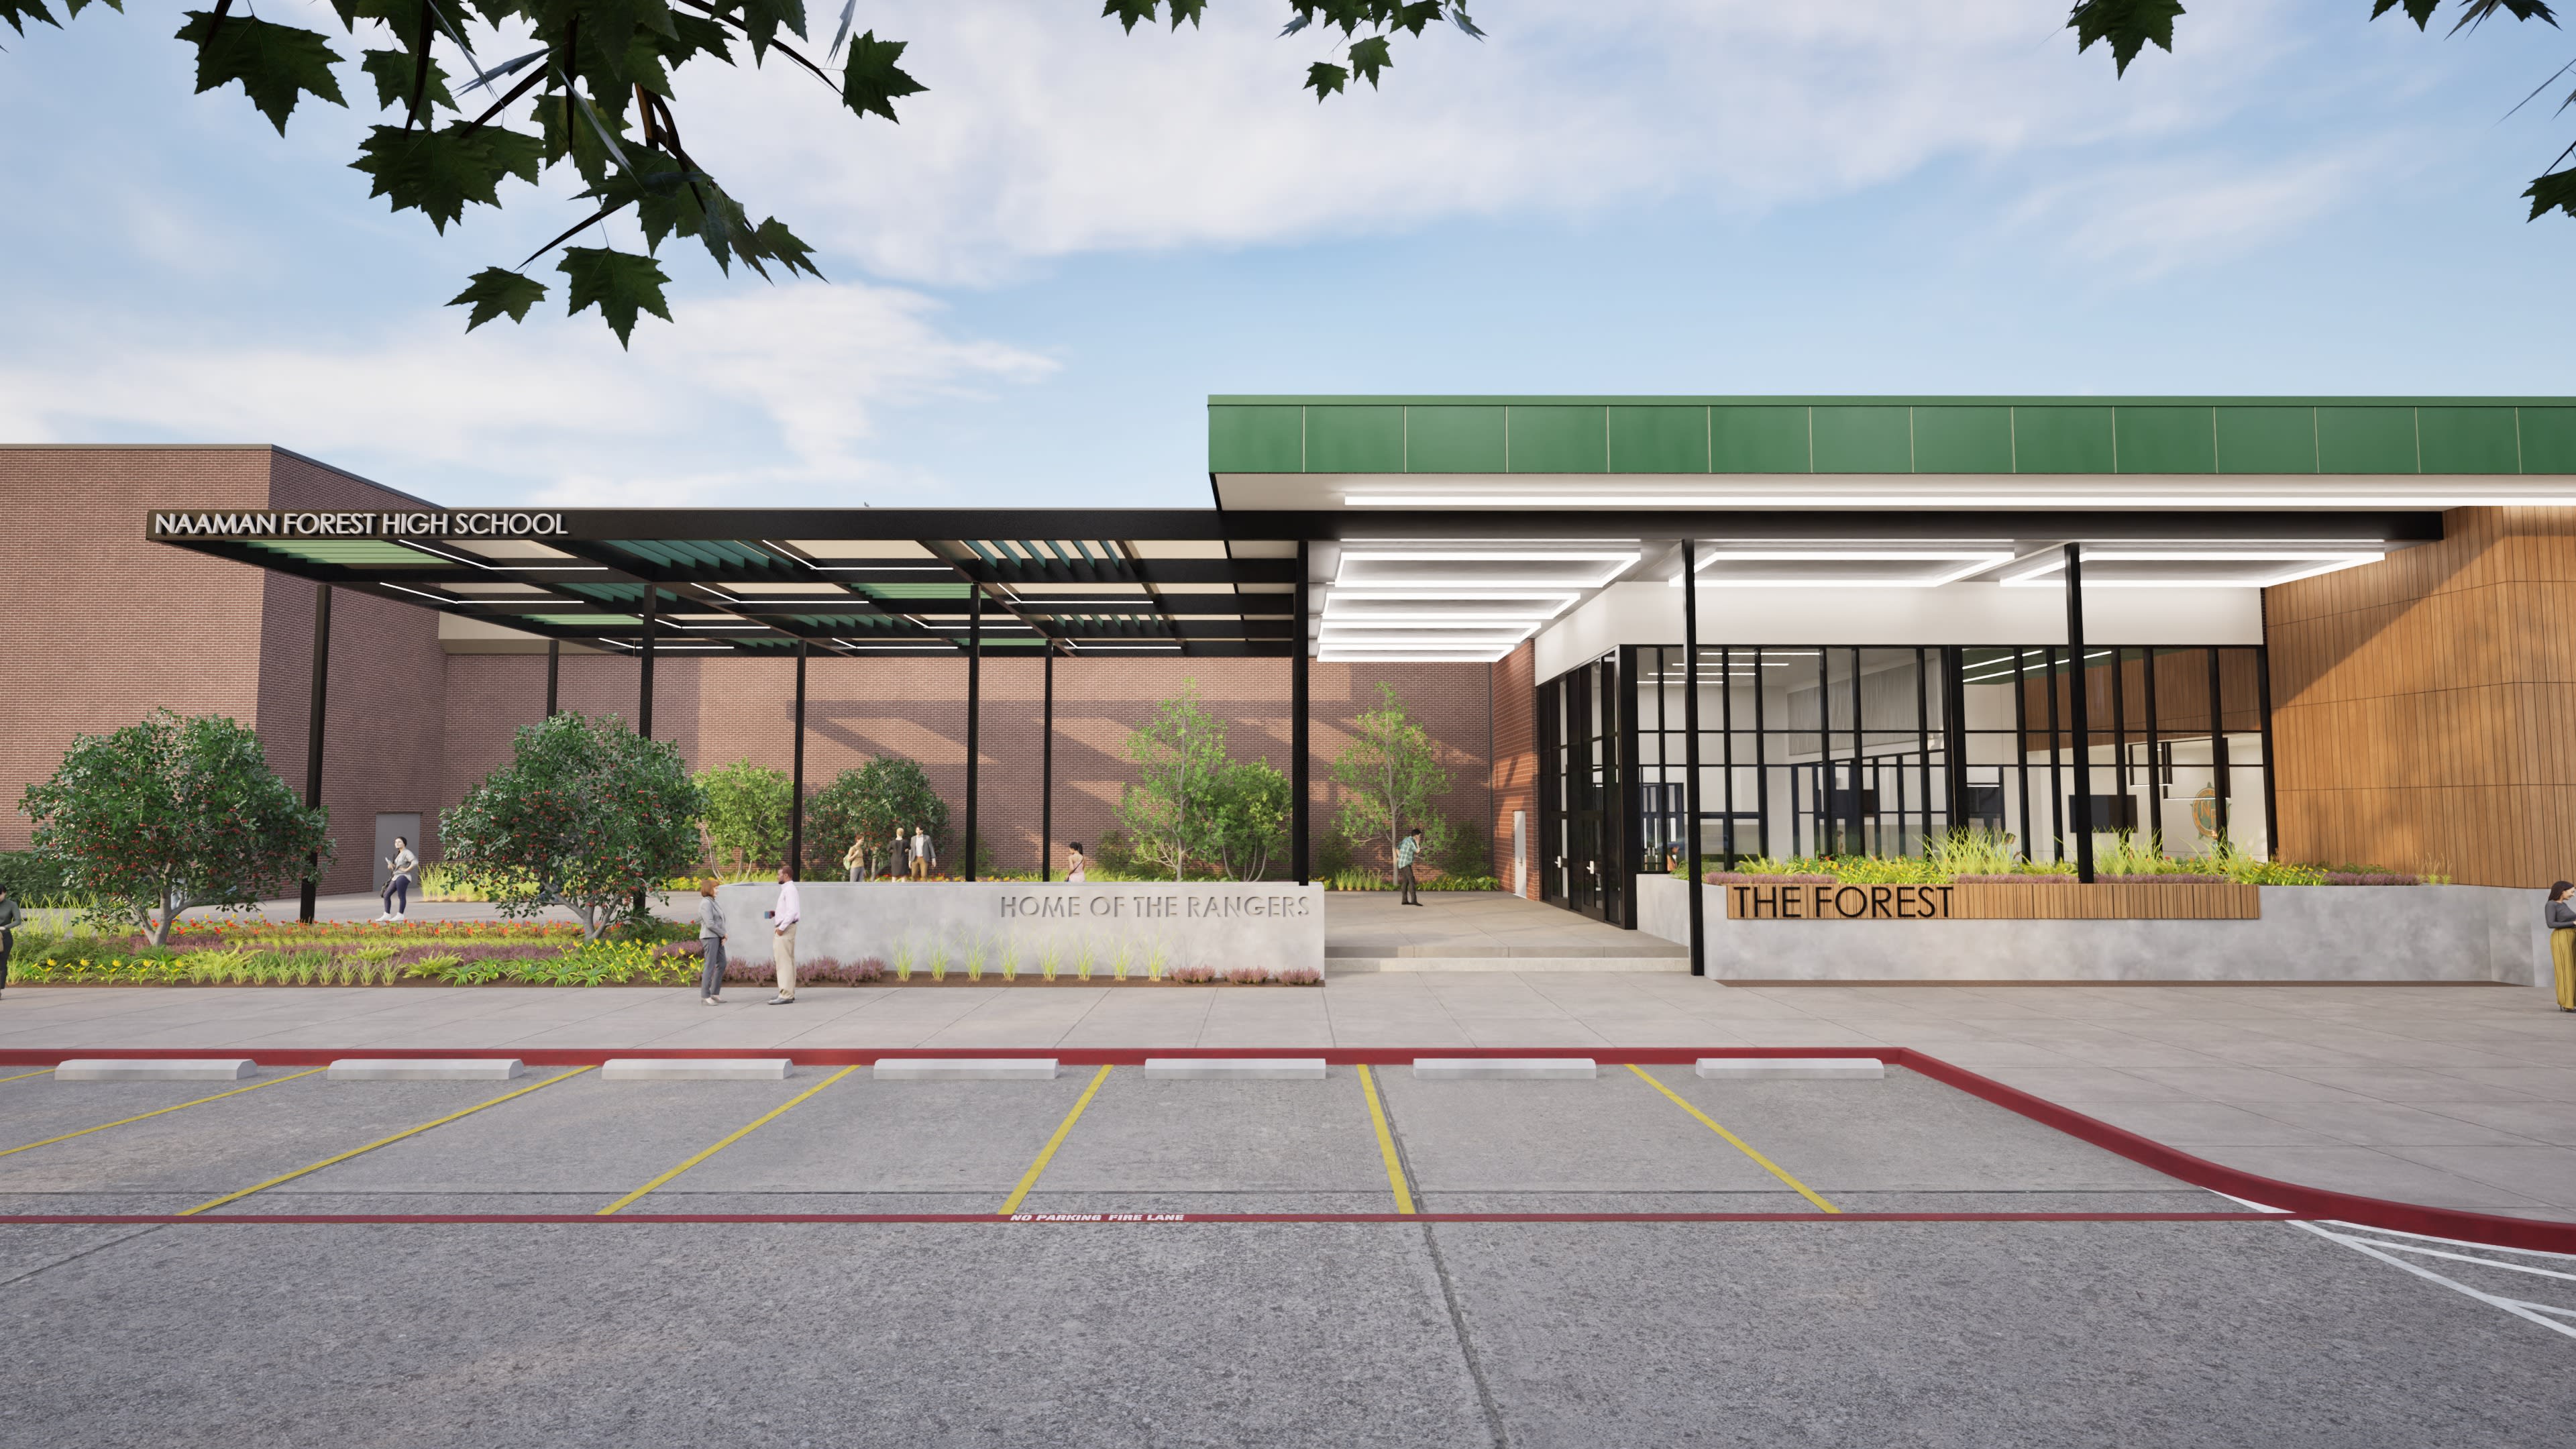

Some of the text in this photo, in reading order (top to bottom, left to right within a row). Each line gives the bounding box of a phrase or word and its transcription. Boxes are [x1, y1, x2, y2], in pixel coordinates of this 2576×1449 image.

[155, 513, 569, 535] NAAMAN FOREST HIGH SCHOOL
[1000, 896, 1310, 918] HOME OF THE RANGERS
[1733, 886, 1953, 918] THE FOREST
